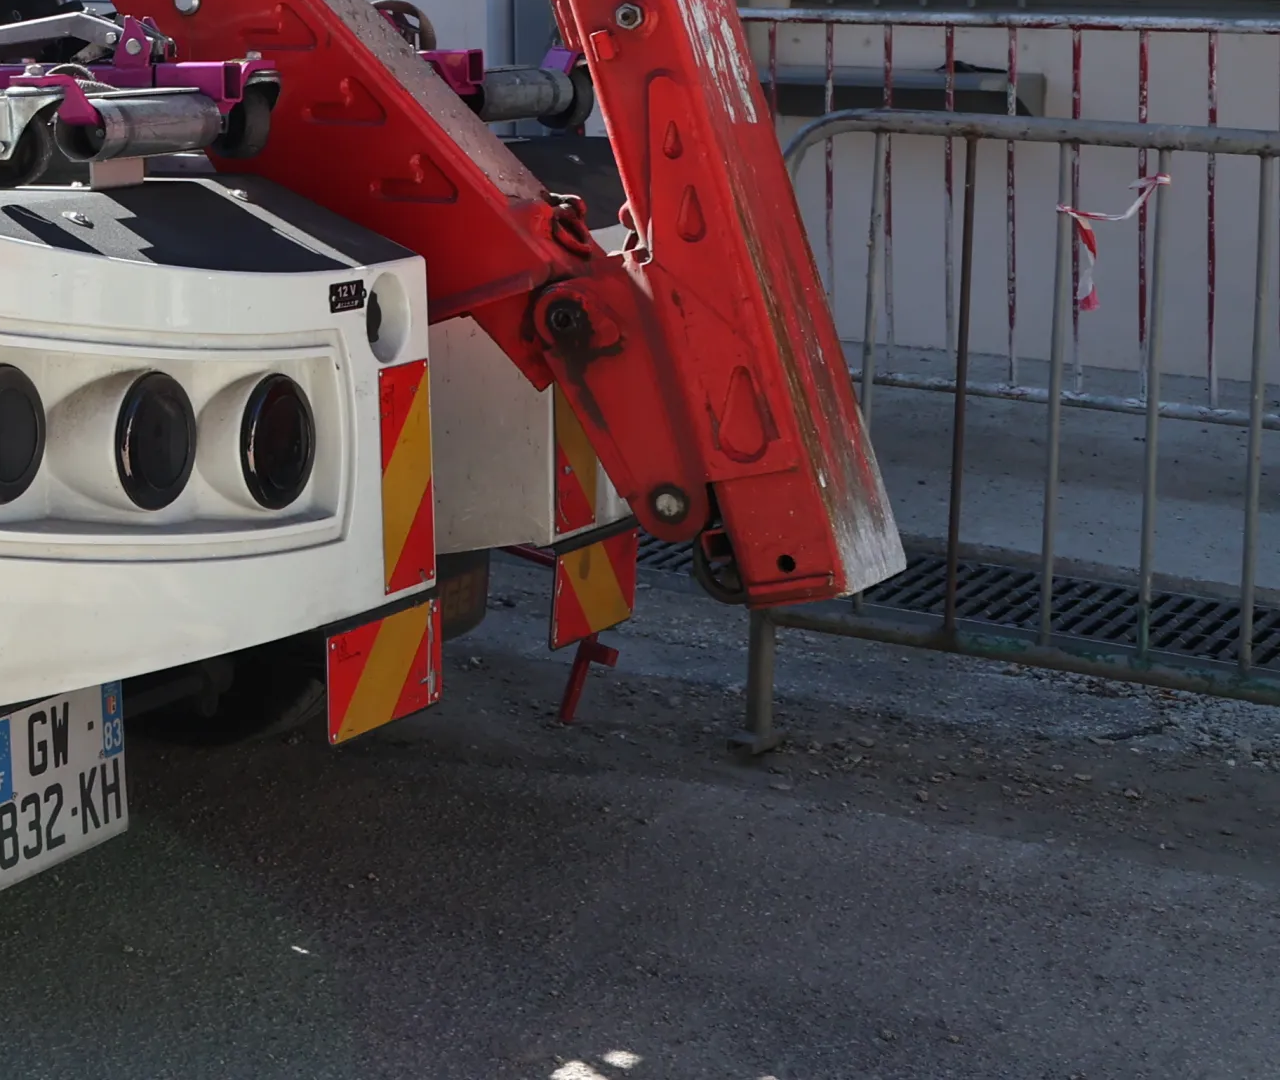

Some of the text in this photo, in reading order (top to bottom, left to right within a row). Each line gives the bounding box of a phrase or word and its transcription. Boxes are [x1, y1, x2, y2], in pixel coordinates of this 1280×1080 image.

[337, 284, 357, 298] 12 V
[104, 718, 123, 752] 83
